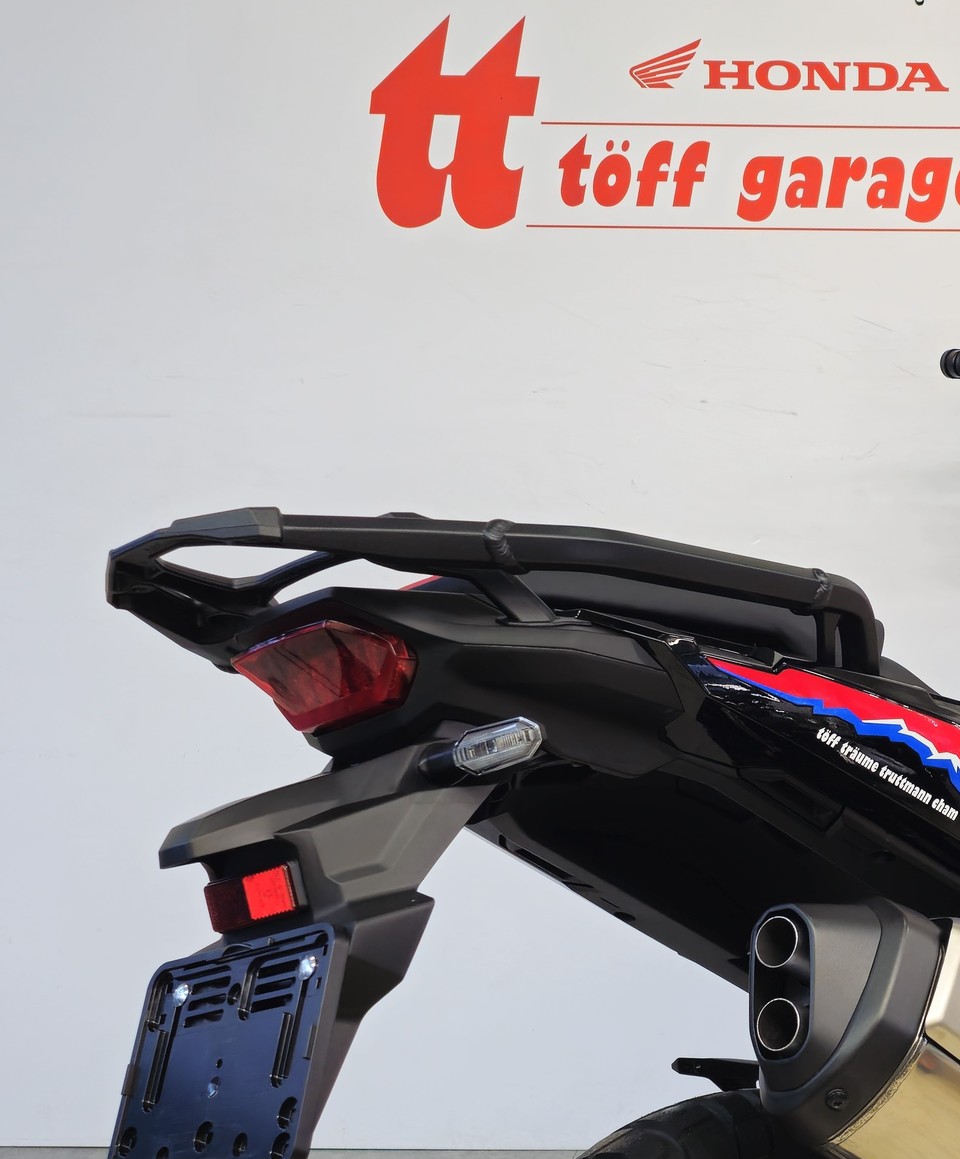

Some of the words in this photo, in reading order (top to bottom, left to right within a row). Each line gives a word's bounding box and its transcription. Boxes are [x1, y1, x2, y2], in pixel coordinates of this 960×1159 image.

[703, 60, 949, 92] HONDA
[558, 134, 711, 208] töff
[816, 726, 839, 749] töff
[840, 740, 879, 773] träume
[878, 765, 932, 805] truttmann
[931, 796, 960, 822] cham
